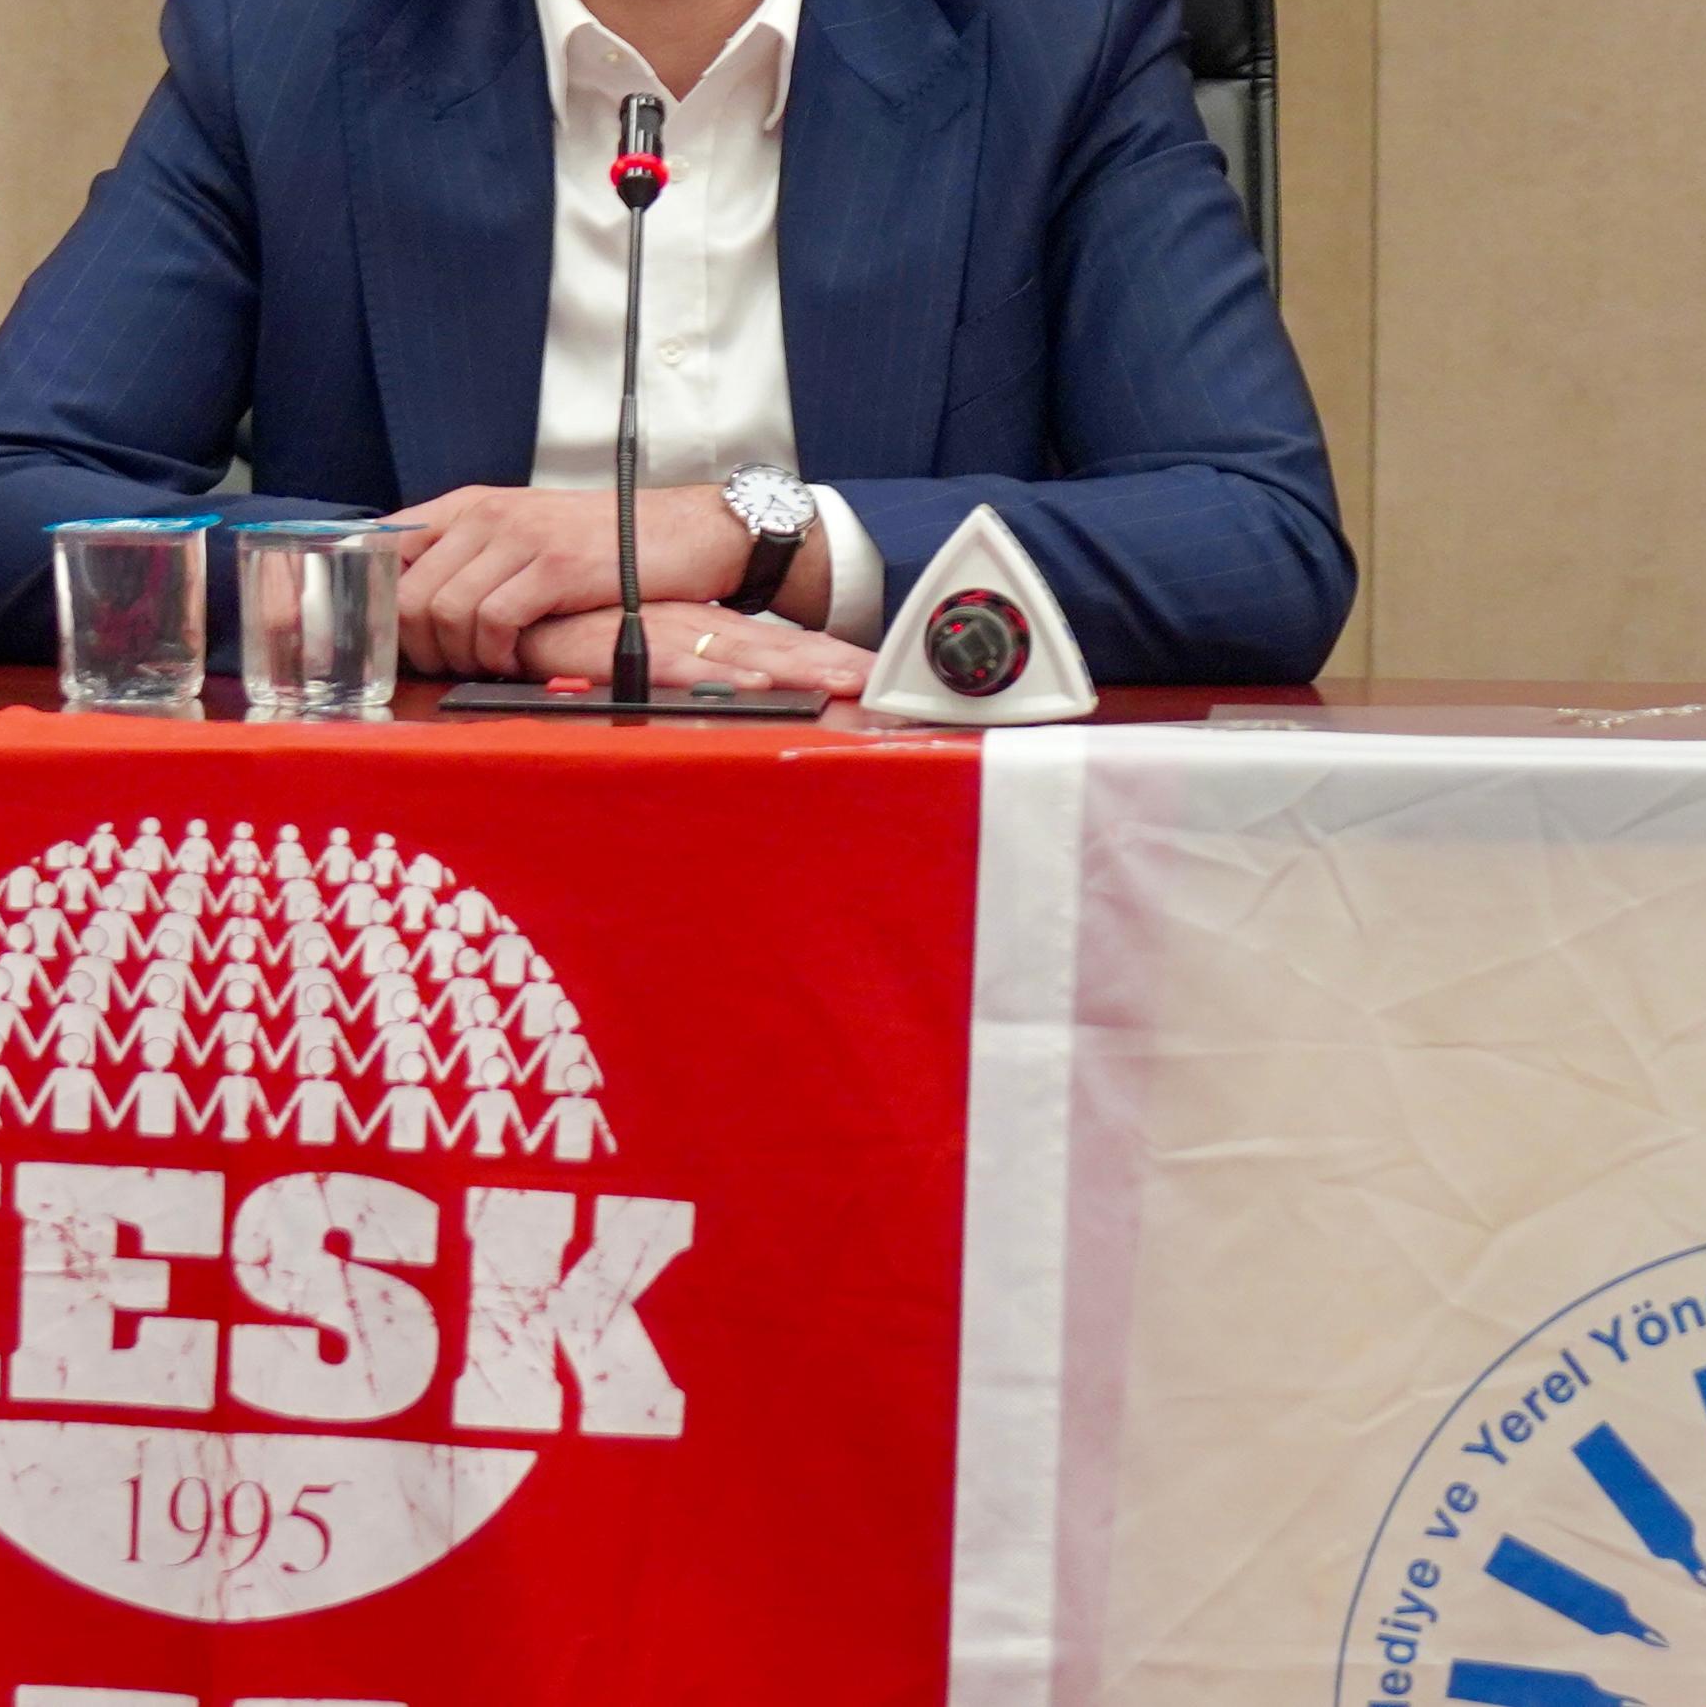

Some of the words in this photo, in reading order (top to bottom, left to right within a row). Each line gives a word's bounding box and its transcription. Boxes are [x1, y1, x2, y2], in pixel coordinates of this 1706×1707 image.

[1423, 1480, 1480, 1540] ve
[1460, 1347, 1592, 1466] Yerel
[120, 1473, 354, 1575] 1995
